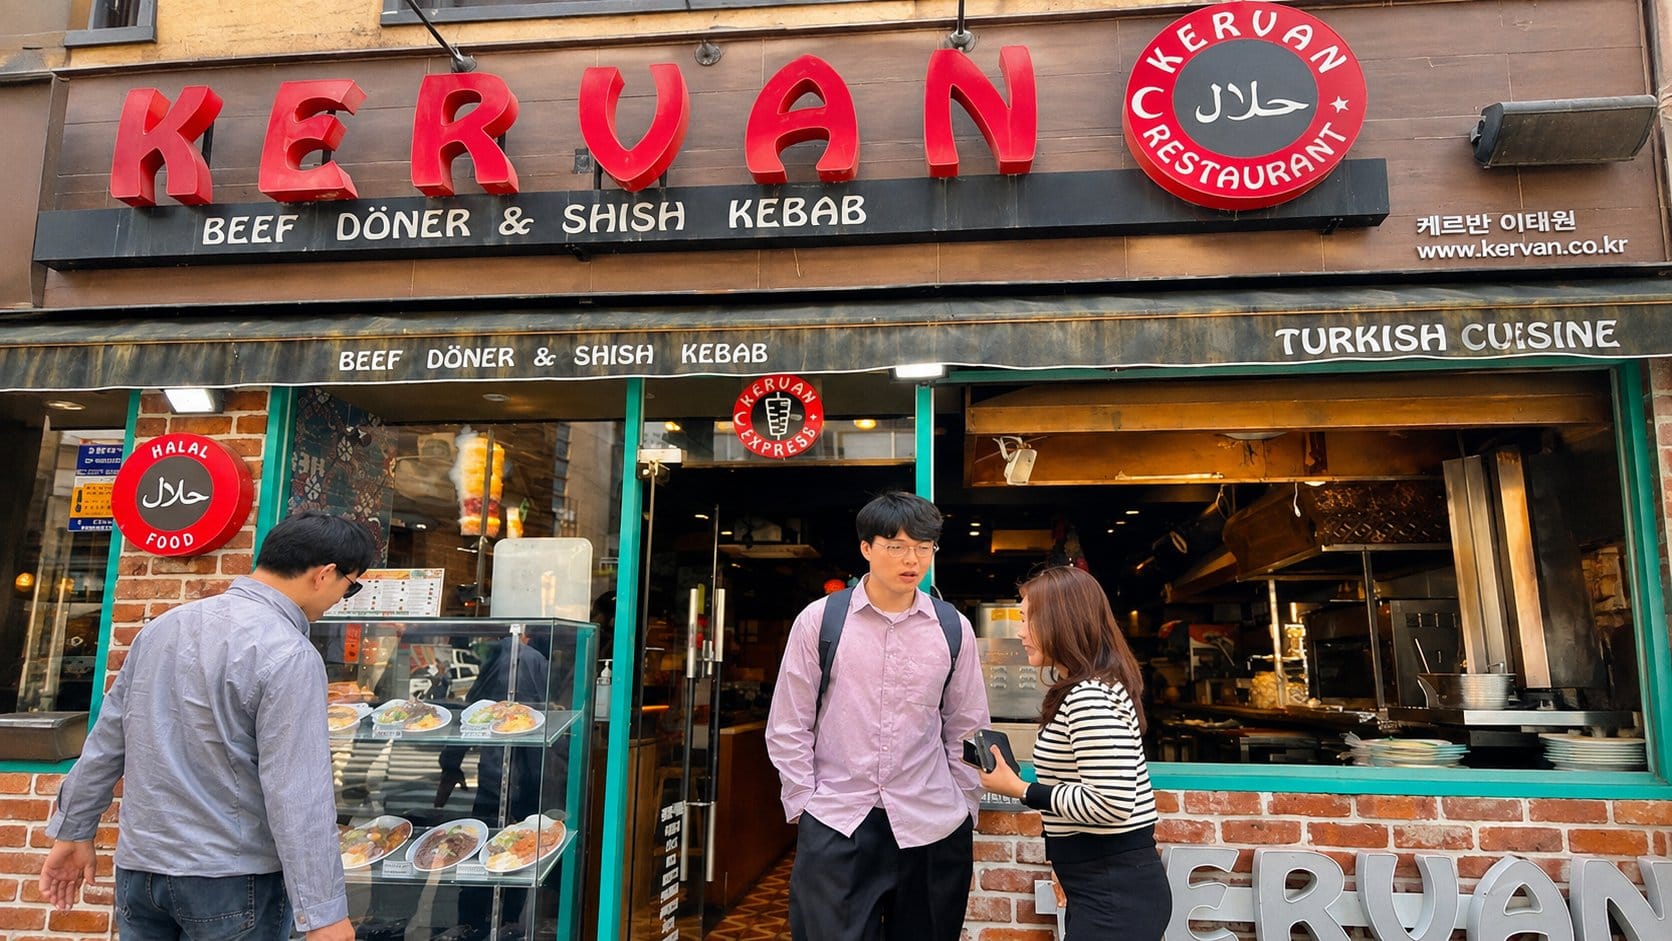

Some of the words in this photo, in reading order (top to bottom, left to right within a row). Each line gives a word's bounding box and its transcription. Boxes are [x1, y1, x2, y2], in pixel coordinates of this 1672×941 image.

[1146, 10, 1347, 74] KERVAN
[1195, 80, 1309, 124] حلال
[111, 45, 1038, 207] KERVAN
[1143, 122, 1347, 190] RESTAURANT
[202, 214, 299, 245] BEEF
[336, 206, 471, 241] DÖNER
[498, 205, 534, 236] &
[562, 201, 685, 235] SHISH
[728, 195, 868, 229] KEBAB
[1417, 213, 1492, 236] 케르반
[1500, 210, 1576, 233] 이태원
[1417, 235, 1628, 260] www.kervan.co.kr
[1275, 323, 1447, 356] TURKISH
[338, 350, 403, 371] BEEF
[426, 345, 516, 368] DÖNER
[533, 347, 556, 367] &
[573, 343, 654, 366] SHISH
[681, 343, 769, 365] KEBAB
[151, 440, 209, 459] HALAL
[741, 426, 816, 457] EXPRESS
[142, 476, 209, 509] حلال
[145, 532, 195, 550] FOOD
[1057, 846, 1672, 941] ERVAN
